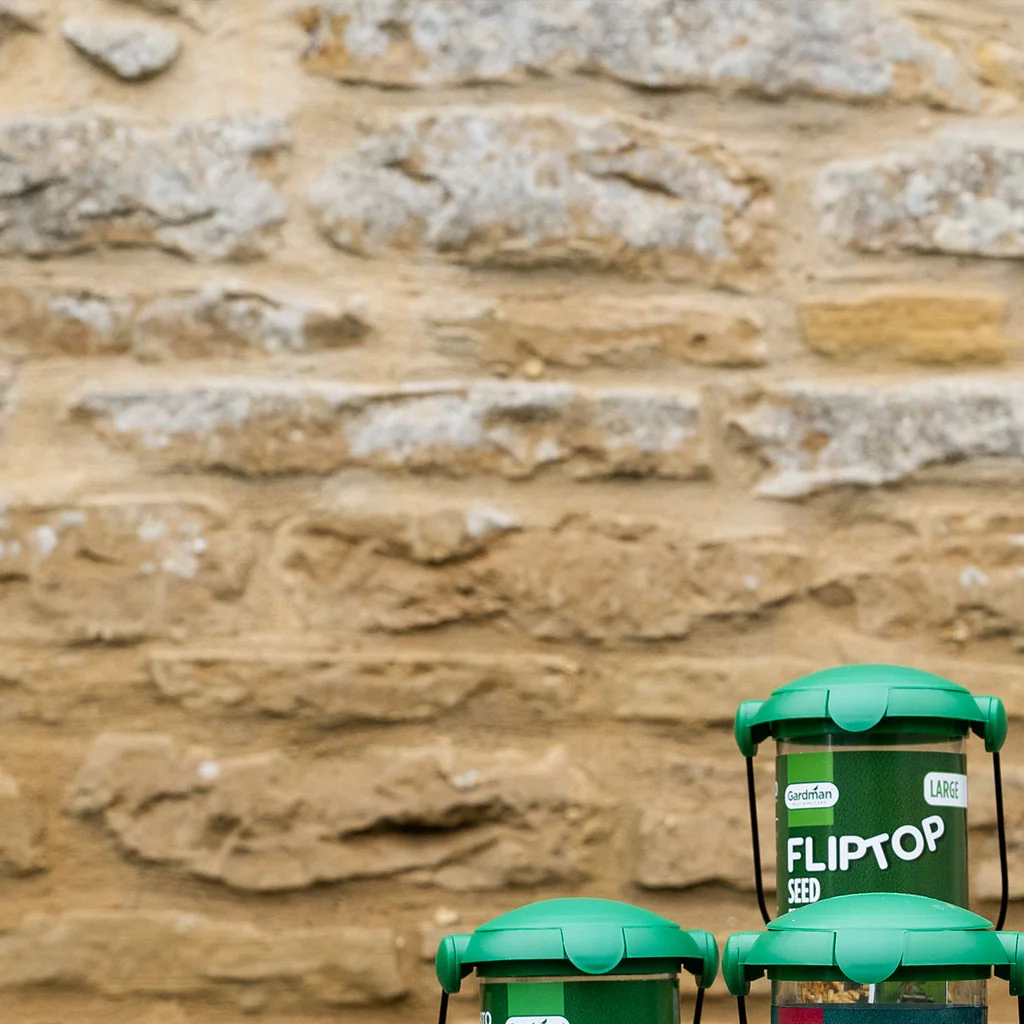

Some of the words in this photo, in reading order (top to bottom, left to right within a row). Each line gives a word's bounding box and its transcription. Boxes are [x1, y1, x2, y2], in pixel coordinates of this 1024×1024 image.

[788, 788, 832, 801] Gardman
[930, 780, 959, 799] LARGE
[787, 815, 945, 873] FLIPTOP
[788, 878, 821, 904] SEED
